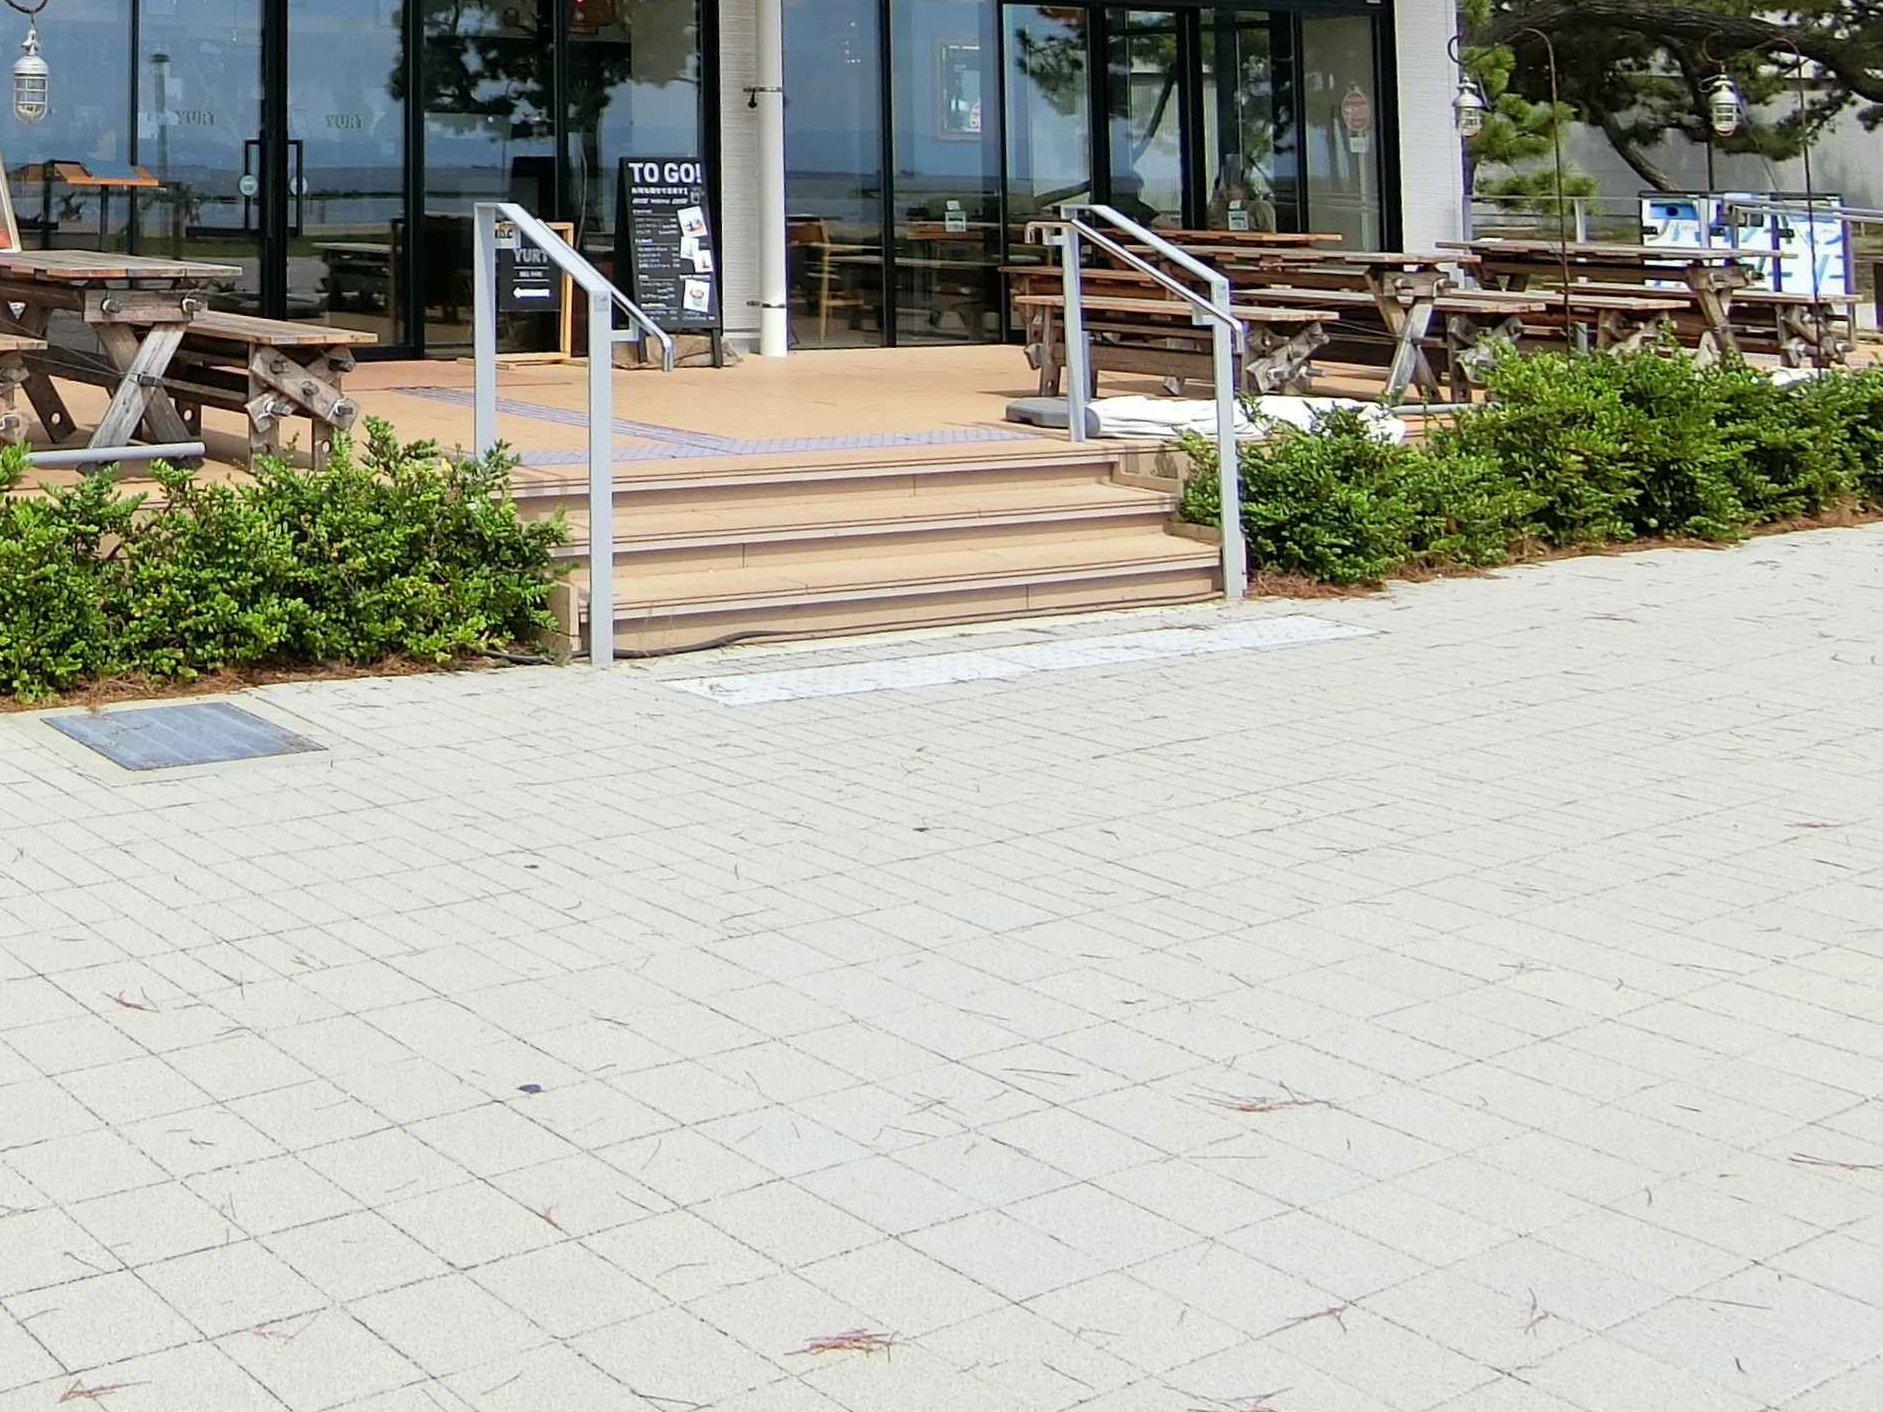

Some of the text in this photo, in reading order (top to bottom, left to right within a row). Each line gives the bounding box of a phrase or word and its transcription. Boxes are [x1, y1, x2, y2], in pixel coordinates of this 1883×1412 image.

[176, 110, 215, 126] YURT
[325, 114, 365, 130] YURT
[628, 162, 702, 184] TO GO!
